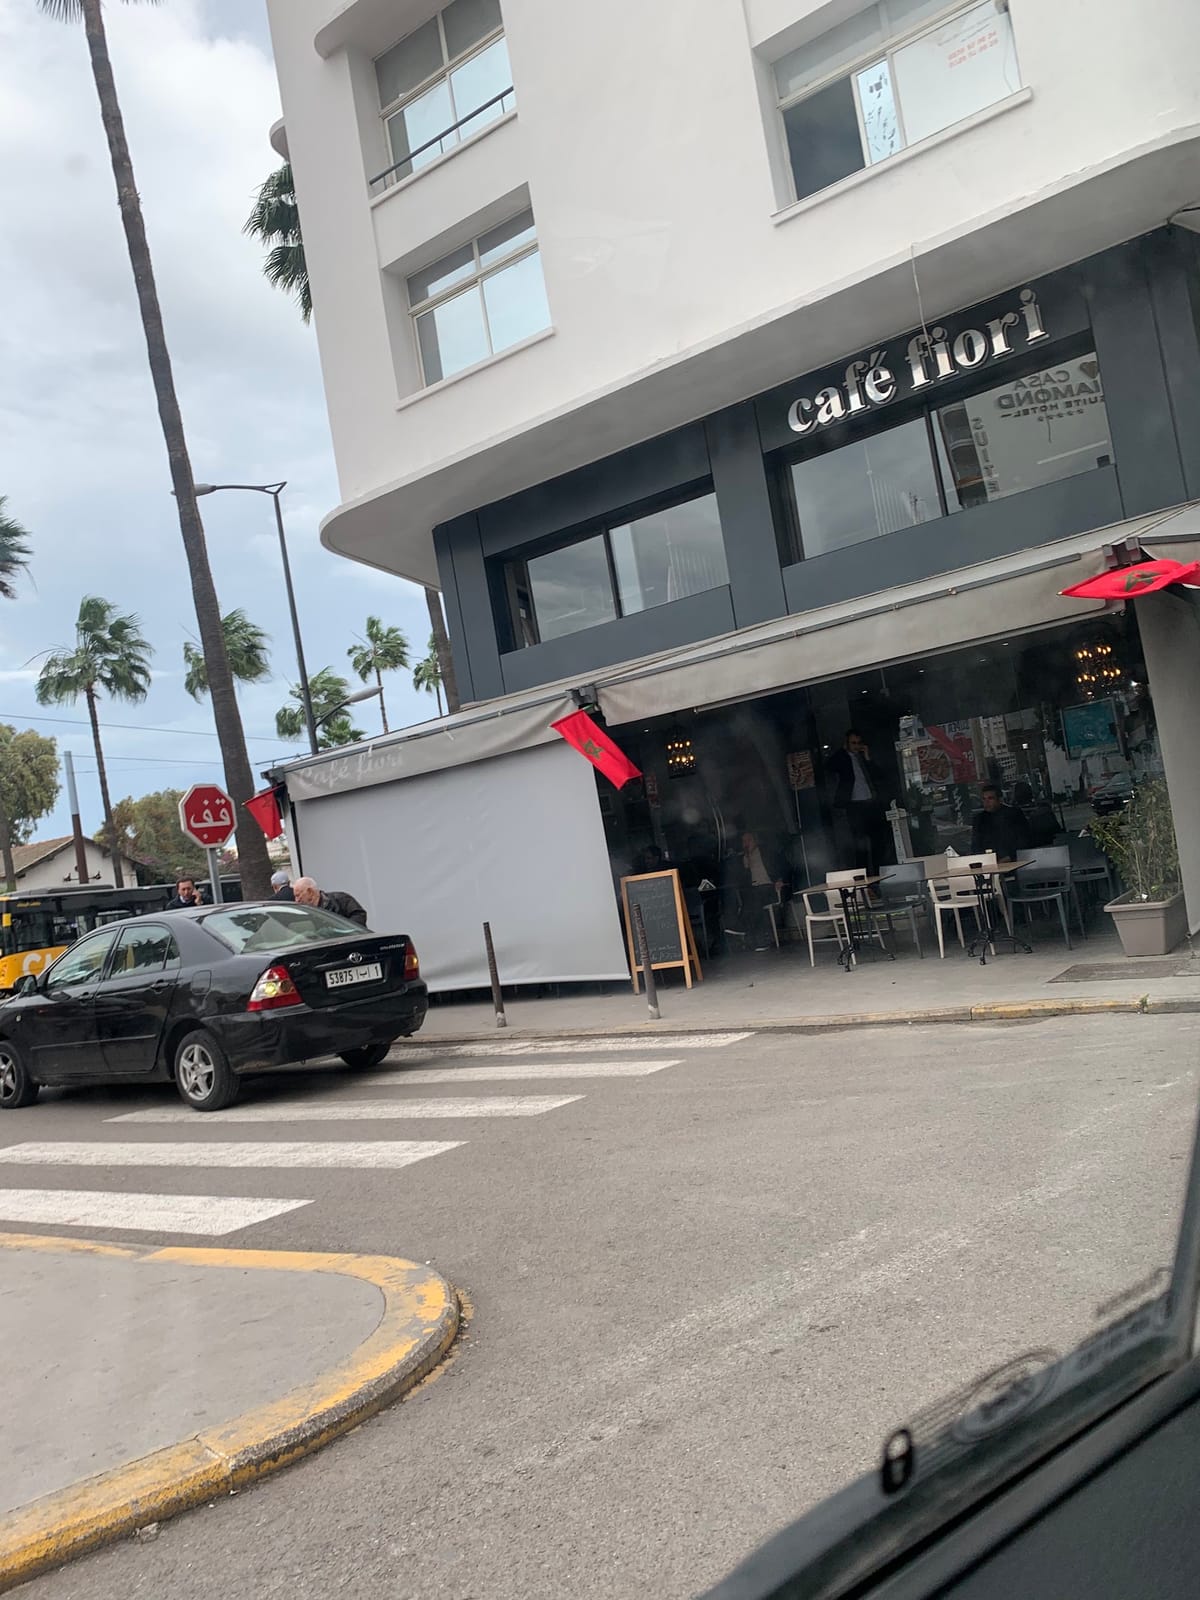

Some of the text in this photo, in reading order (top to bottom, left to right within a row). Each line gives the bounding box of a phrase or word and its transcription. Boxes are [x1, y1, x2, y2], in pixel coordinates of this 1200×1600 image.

[787, 288, 1049, 434] café fiori
[190, 798, 231, 829] قف
[329, 969, 354, 985] 53875
